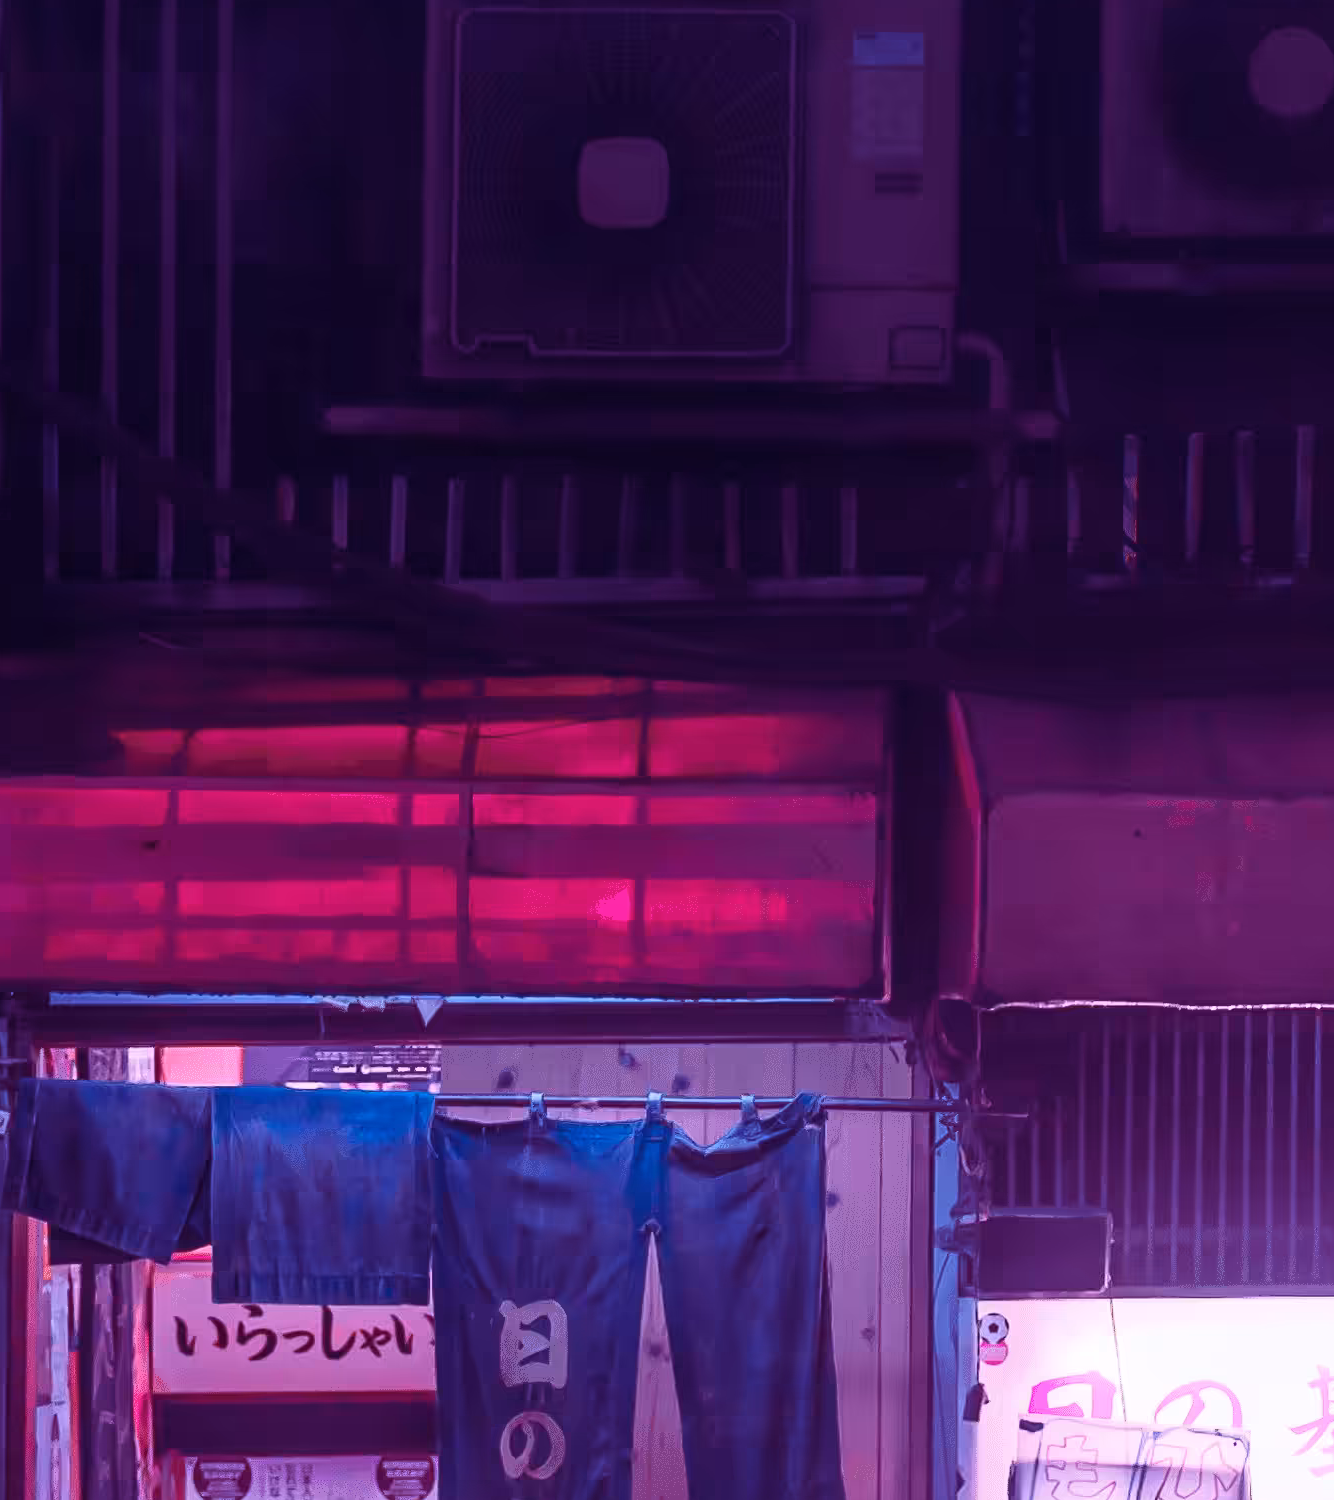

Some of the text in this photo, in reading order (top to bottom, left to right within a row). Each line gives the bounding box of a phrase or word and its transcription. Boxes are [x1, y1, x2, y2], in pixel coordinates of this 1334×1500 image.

[174, 1304, 435, 1361] いらっしゃい
